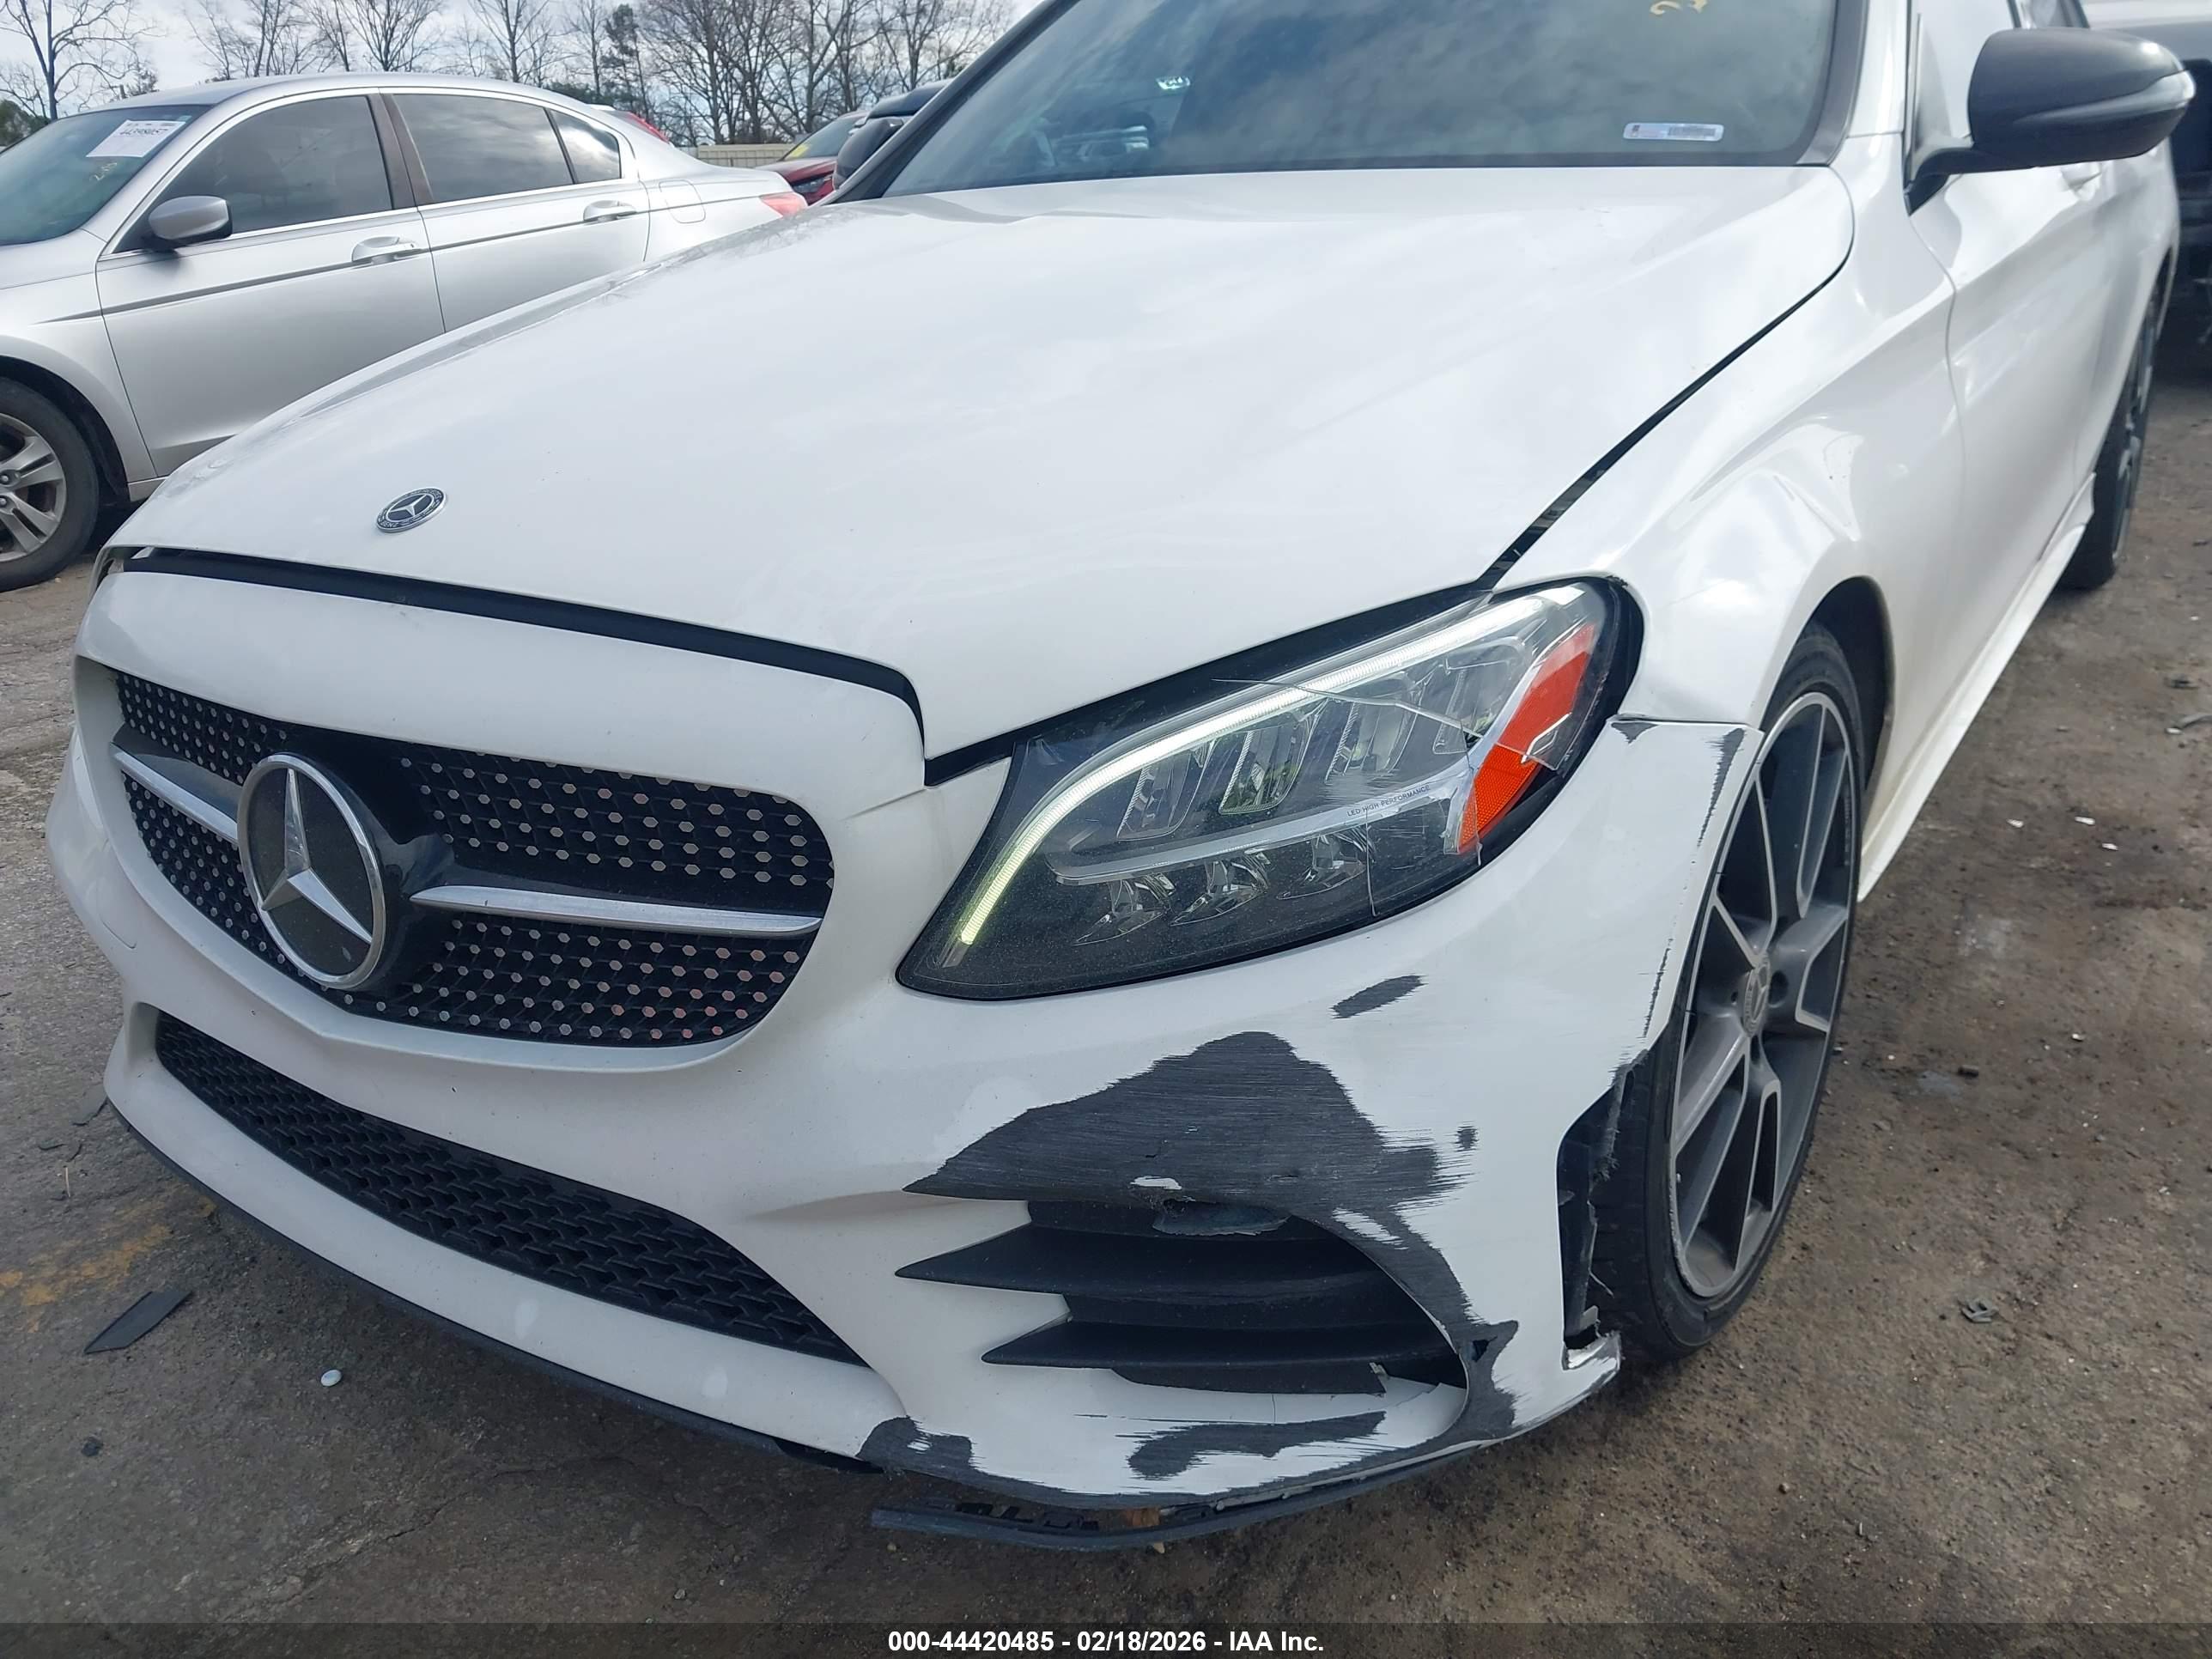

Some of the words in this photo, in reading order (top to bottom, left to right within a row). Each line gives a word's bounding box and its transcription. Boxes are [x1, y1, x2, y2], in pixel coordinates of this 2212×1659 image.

[1346, 808, 1361, 817] LED
[1362, 803, 1379, 812] HIGH
[1380, 785, 1431, 807] PERFORMANCE
